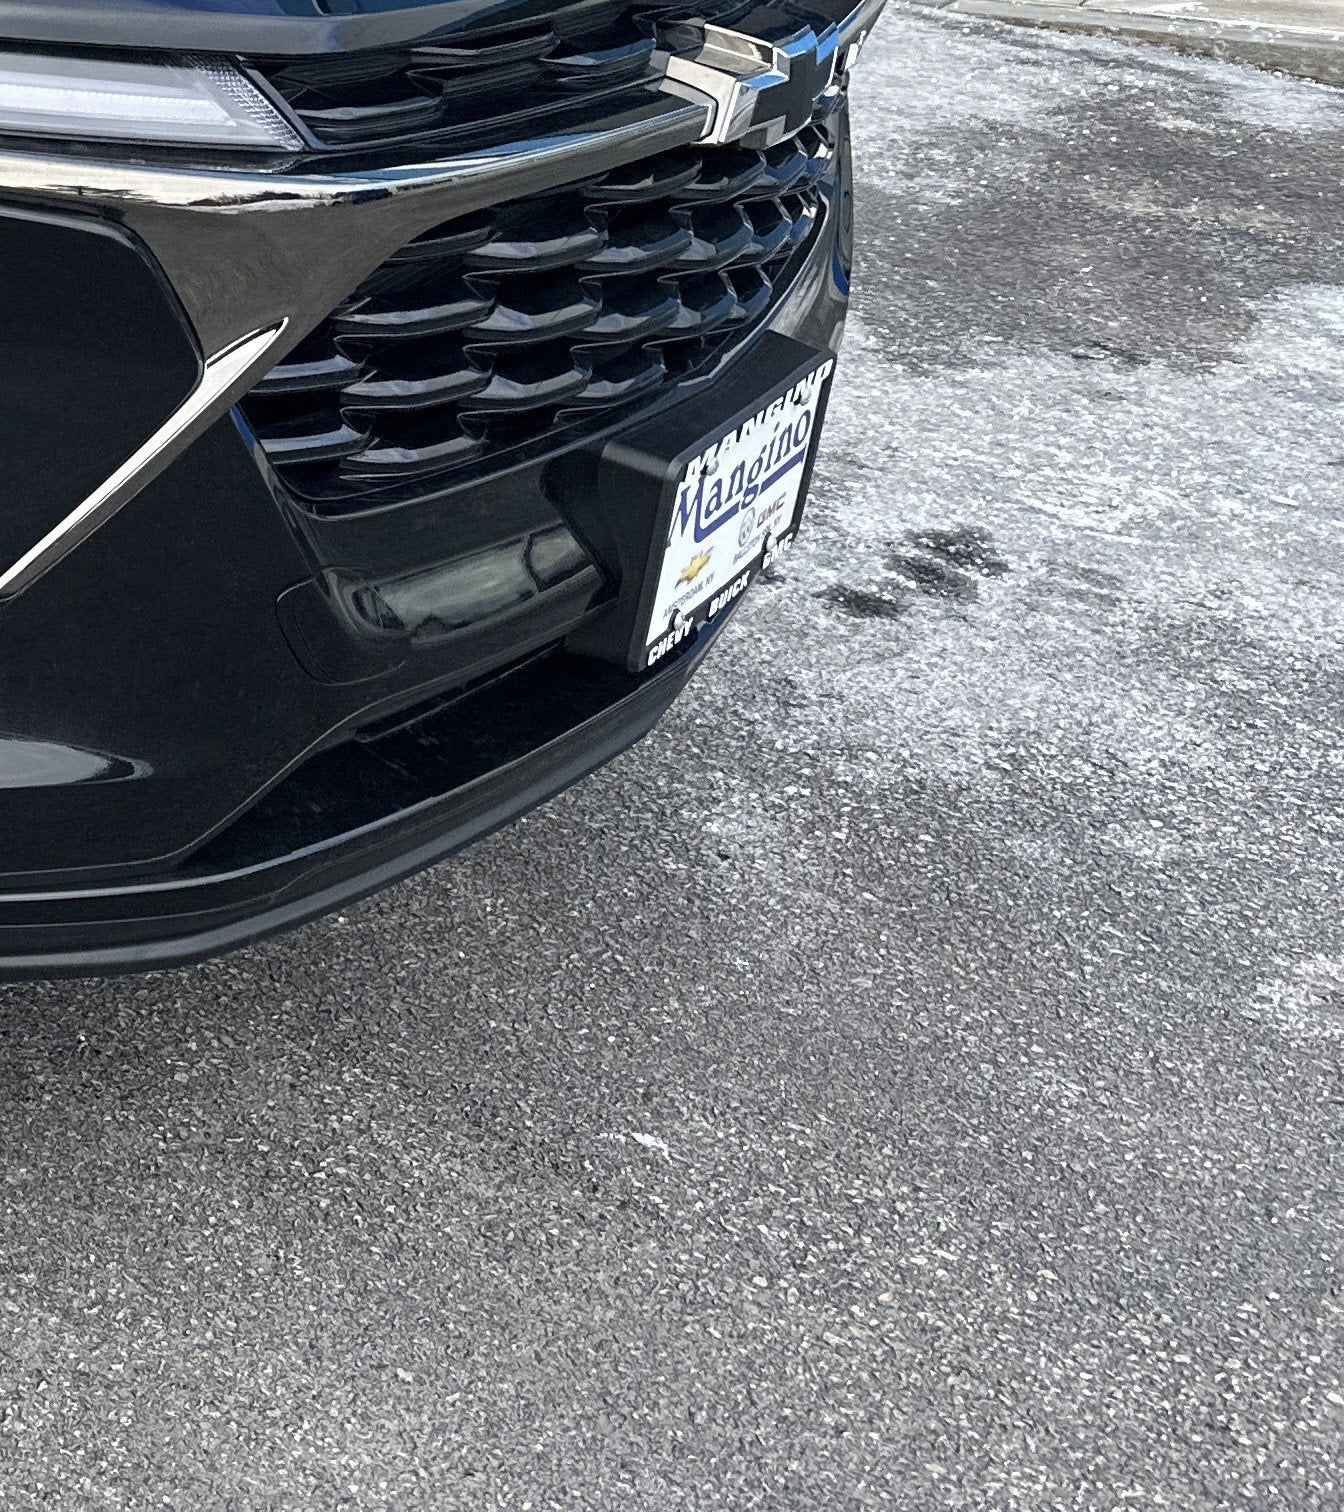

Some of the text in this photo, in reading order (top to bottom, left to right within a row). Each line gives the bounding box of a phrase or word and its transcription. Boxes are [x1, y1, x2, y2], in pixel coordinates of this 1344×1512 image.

[665, 409, 811, 544] Mangino
[757, 492, 786, 528] GMC
[647, 532, 793, 666] CHEVY BUICK GMC
